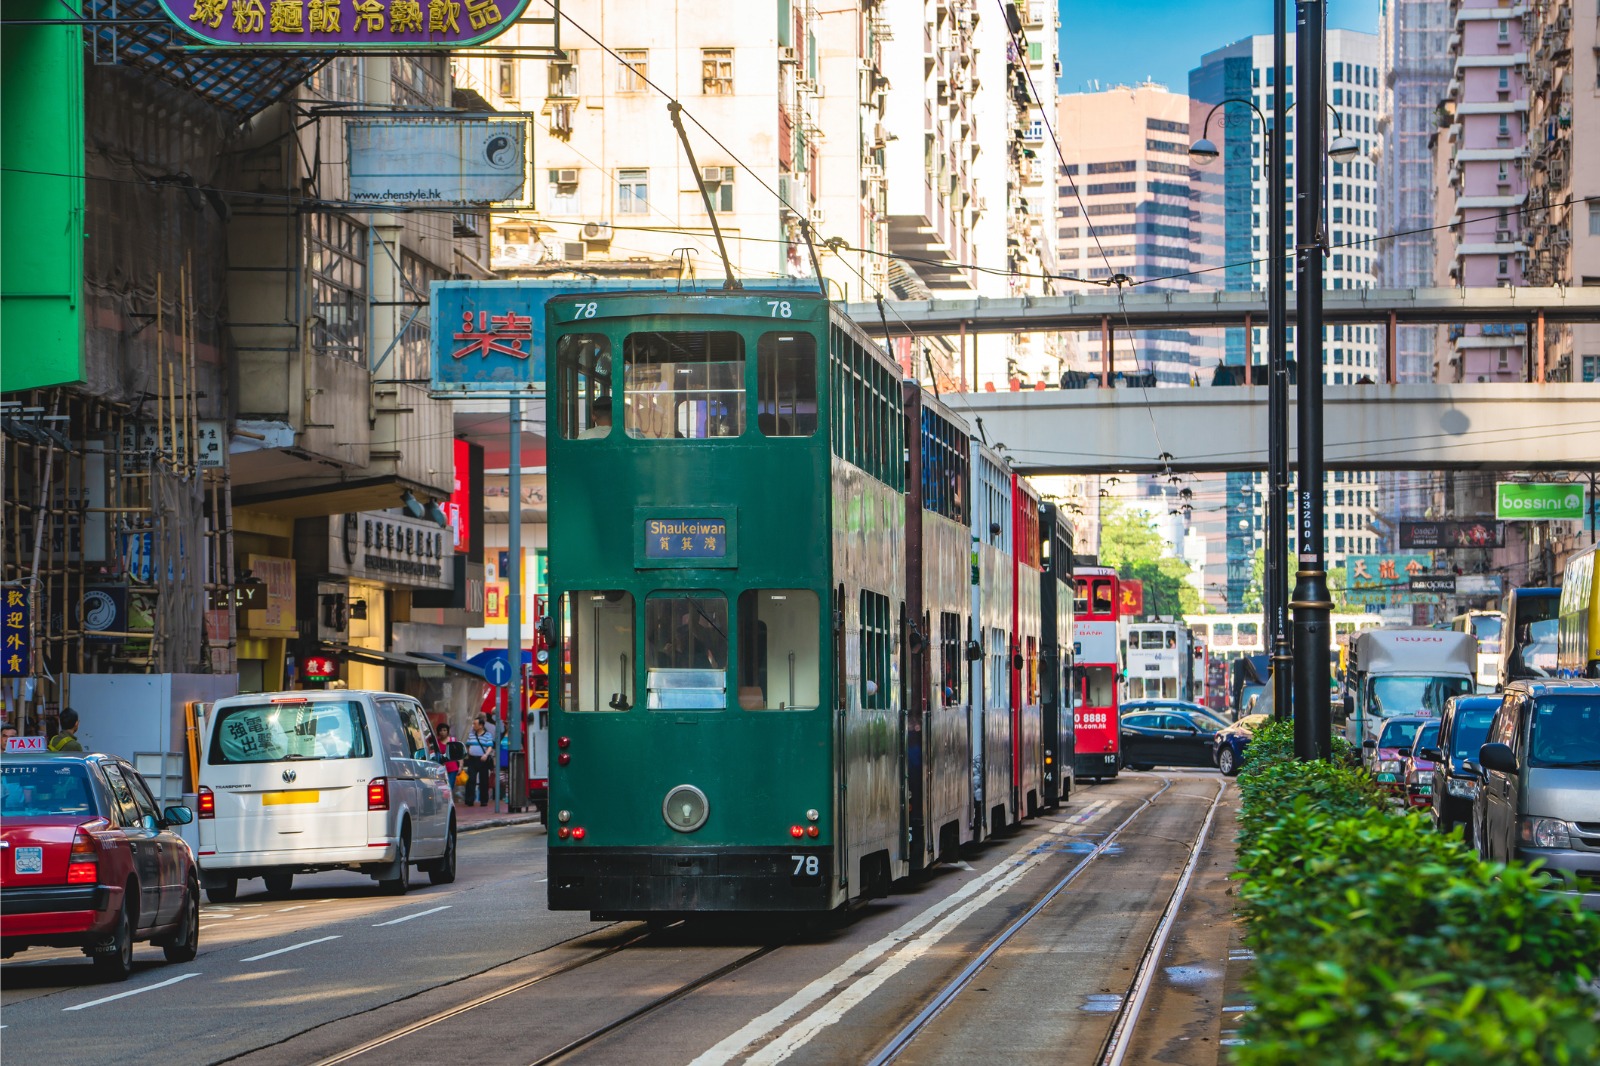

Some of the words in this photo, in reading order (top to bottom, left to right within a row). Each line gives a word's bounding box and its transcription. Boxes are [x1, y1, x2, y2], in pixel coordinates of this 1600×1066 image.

[354, 189, 441, 200] www.chenstyle.hk
[574, 302, 598, 319] 78
[767, 301, 792, 318] 78
[1503, 493, 1561, 510] bossini
[650, 521, 726, 535] Shaukeiwan
[1304, 543, 1311, 551] A
[6, 591, 25, 672] 歡迎外賣
[1083, 713, 1107, 723] 8888
[9, 738, 42, 749] TAXI
[1104, 755, 1115, 763] 112
[791, 855, 819, 876] 78
